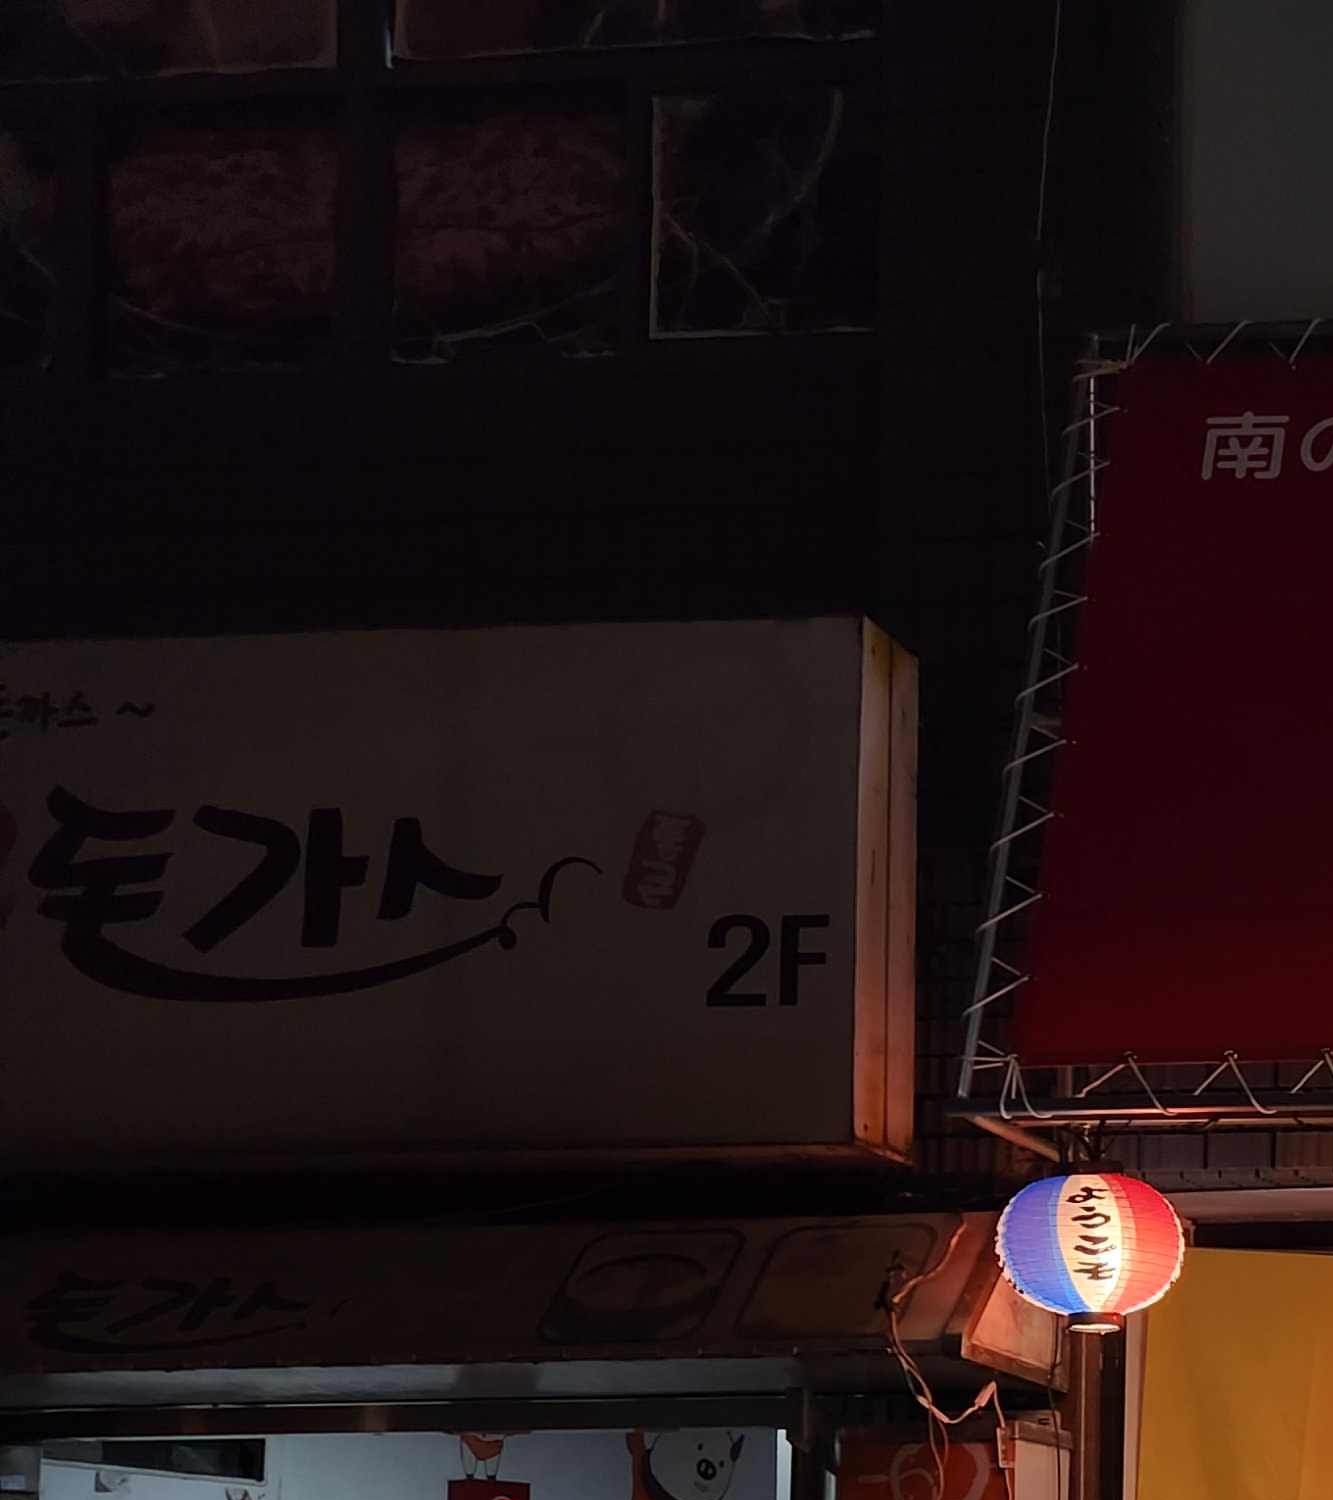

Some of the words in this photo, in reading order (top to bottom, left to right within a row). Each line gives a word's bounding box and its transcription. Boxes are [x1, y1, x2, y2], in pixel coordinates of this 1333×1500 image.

[27, 785, 518, 1001] 돈가스
[705, 914, 830, 1008] 2F
[1066, 1186, 1117, 1280] ようこそ
